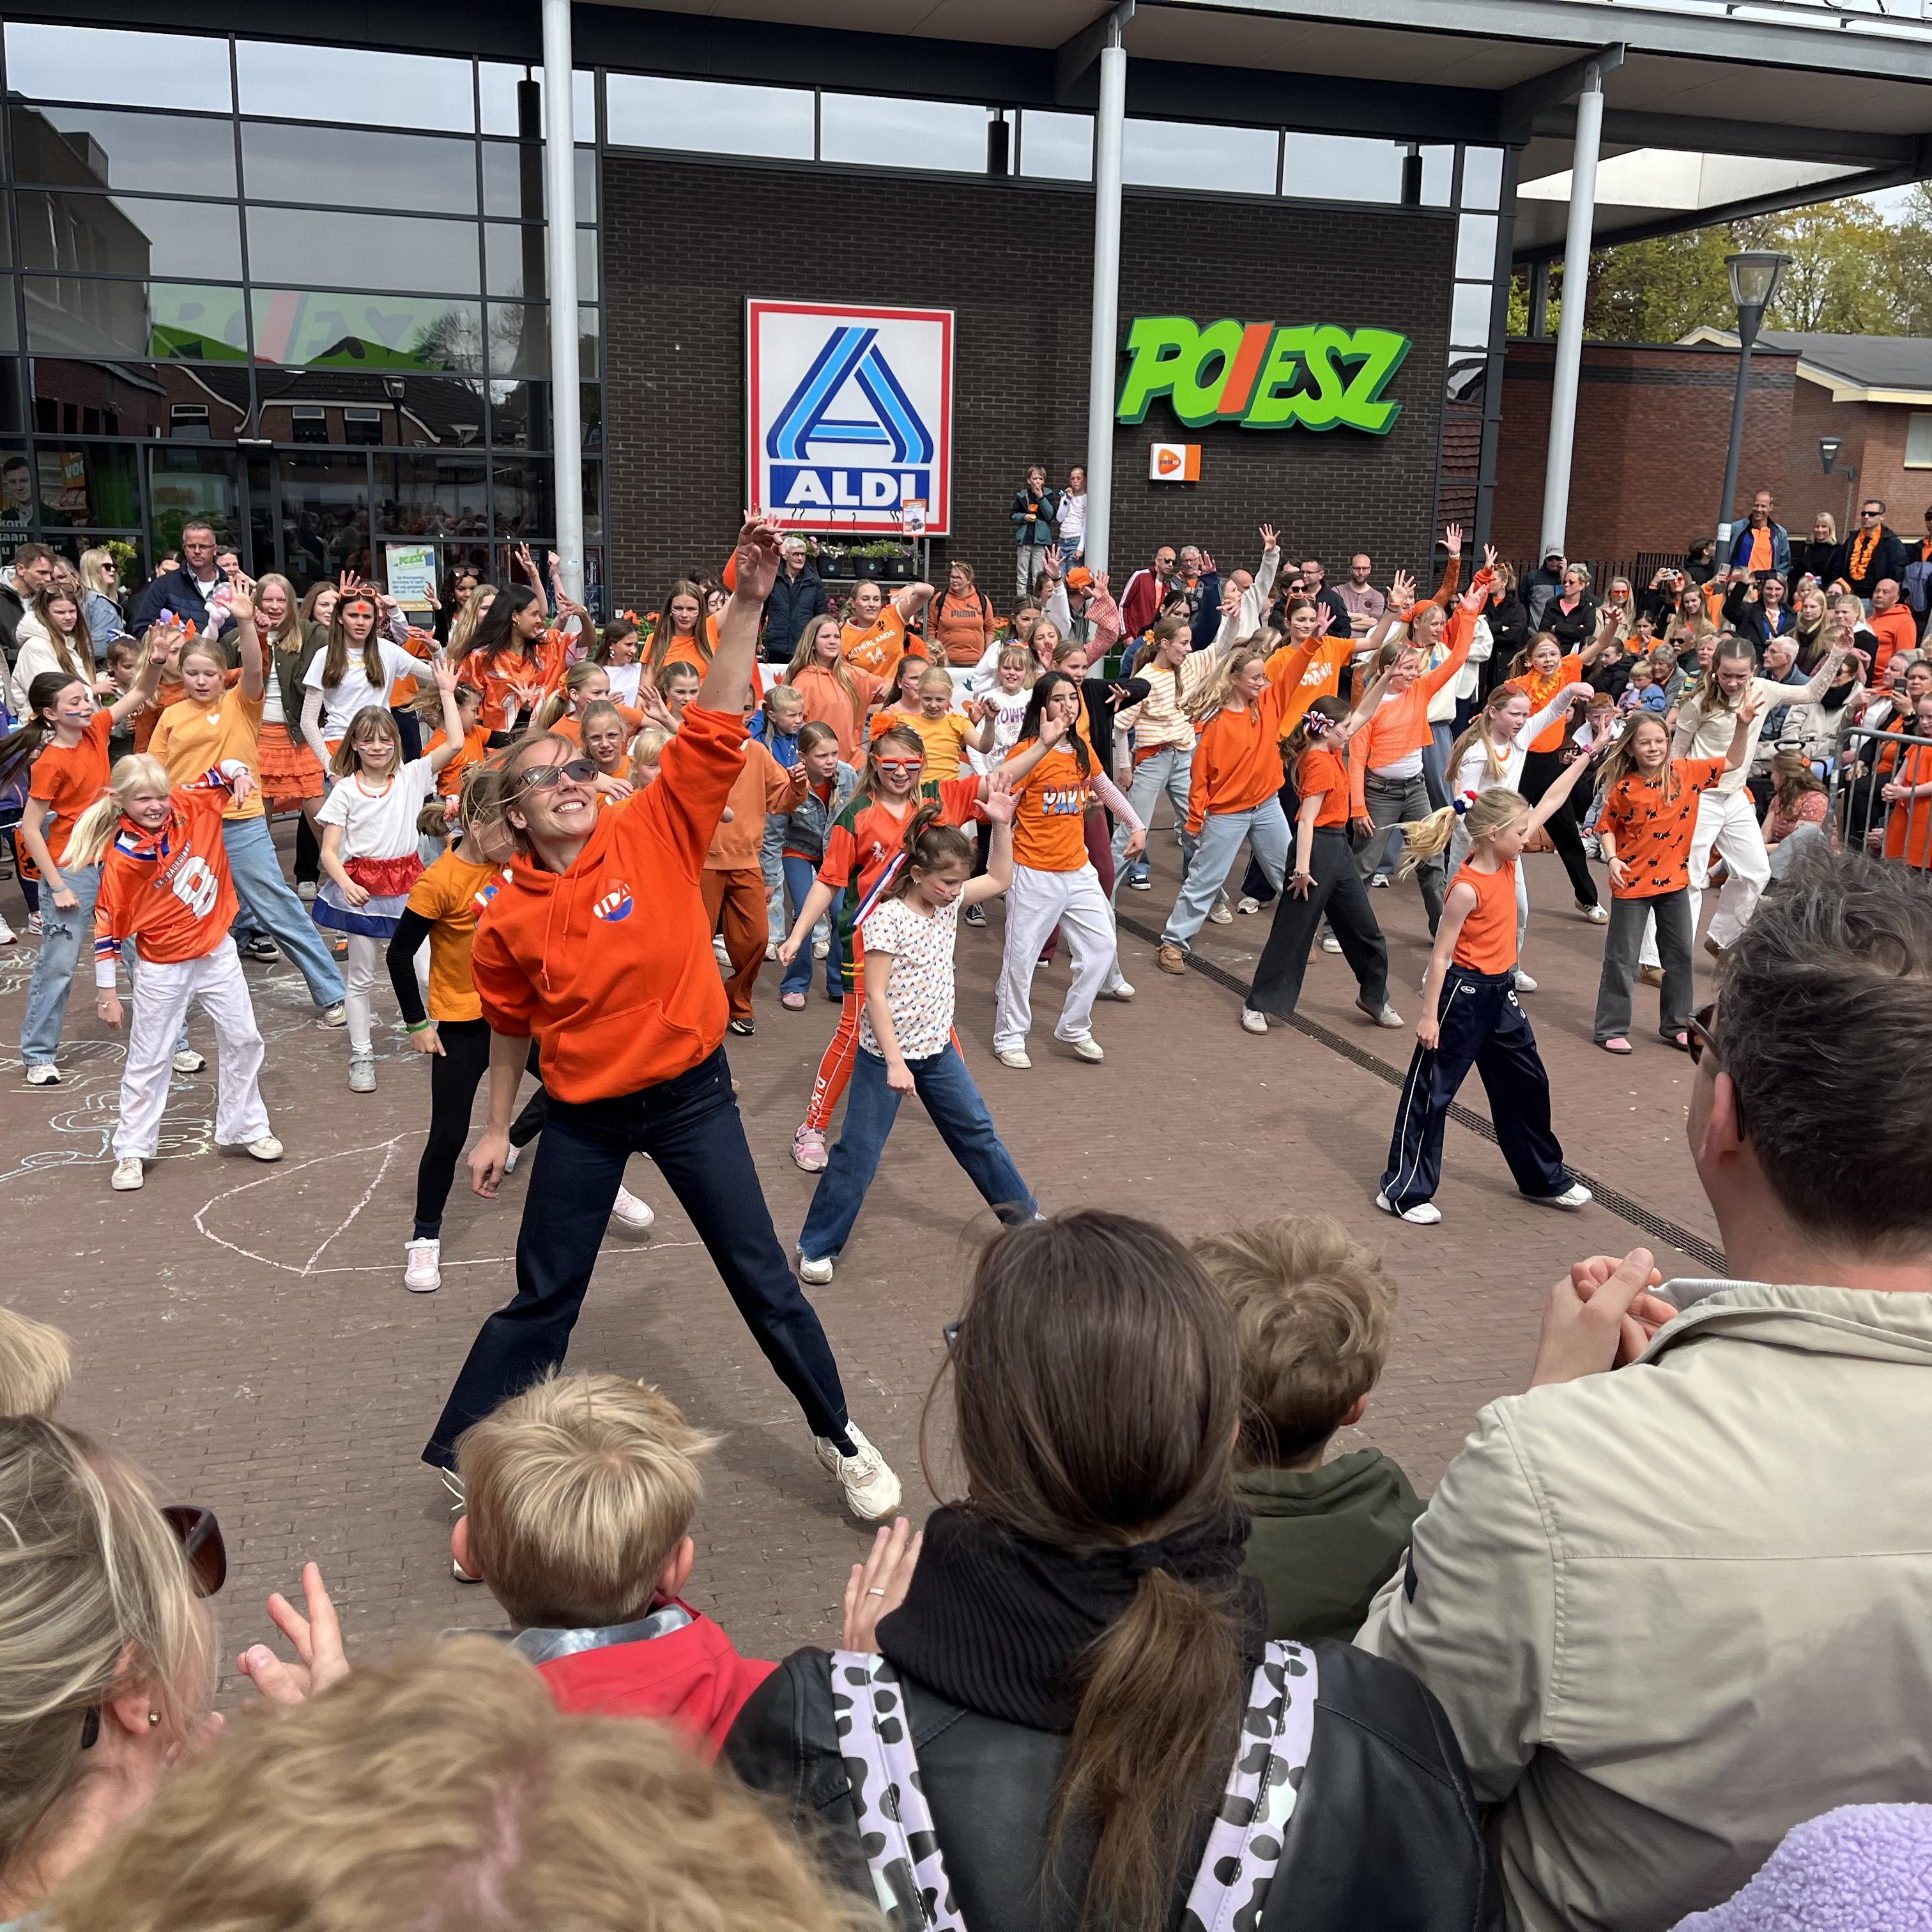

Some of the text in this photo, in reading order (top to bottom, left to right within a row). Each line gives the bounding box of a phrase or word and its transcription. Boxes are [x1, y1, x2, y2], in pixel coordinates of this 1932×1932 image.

[1117, 316, 1411, 434] POIESZ
[785, 470, 916, 508] ALDI
[951, 610, 976, 618] PUMA
[866, 647, 886, 665] 14
